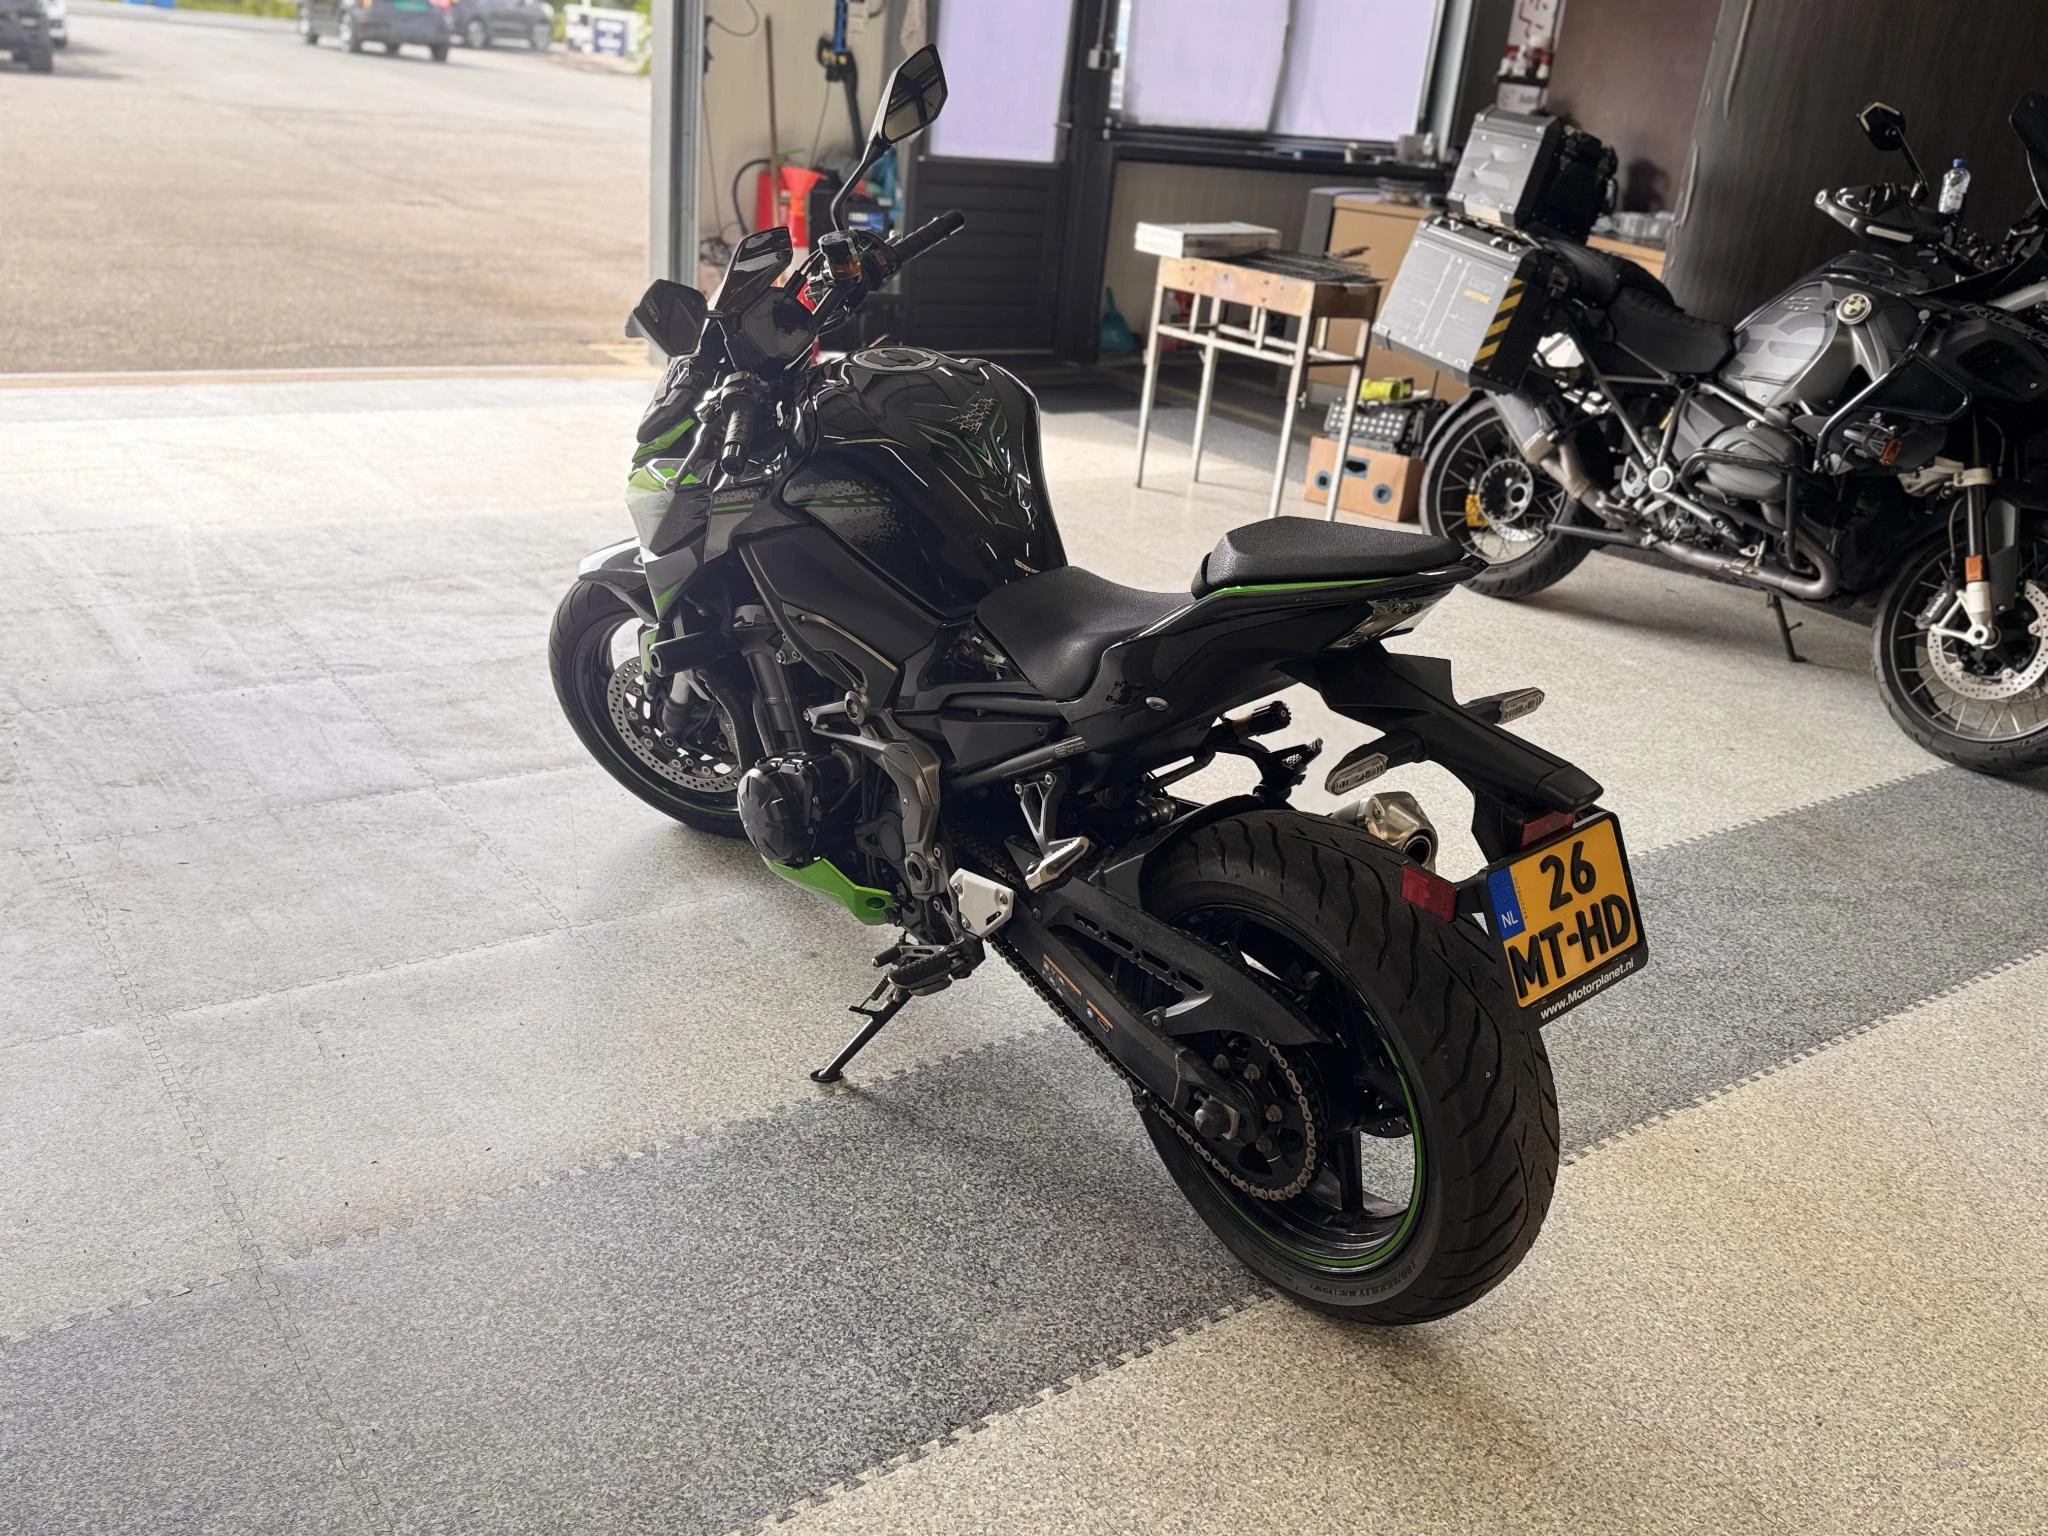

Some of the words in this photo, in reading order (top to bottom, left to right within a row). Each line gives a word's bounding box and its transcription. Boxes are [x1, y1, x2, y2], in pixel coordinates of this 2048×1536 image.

[1540, 841, 1596, 911] 26
[1501, 910, 1518, 928] NL
[1507, 894, 1630, 999] MT-HD
[1540, 957, 1634, 1019] www.Motorplanet.nl
